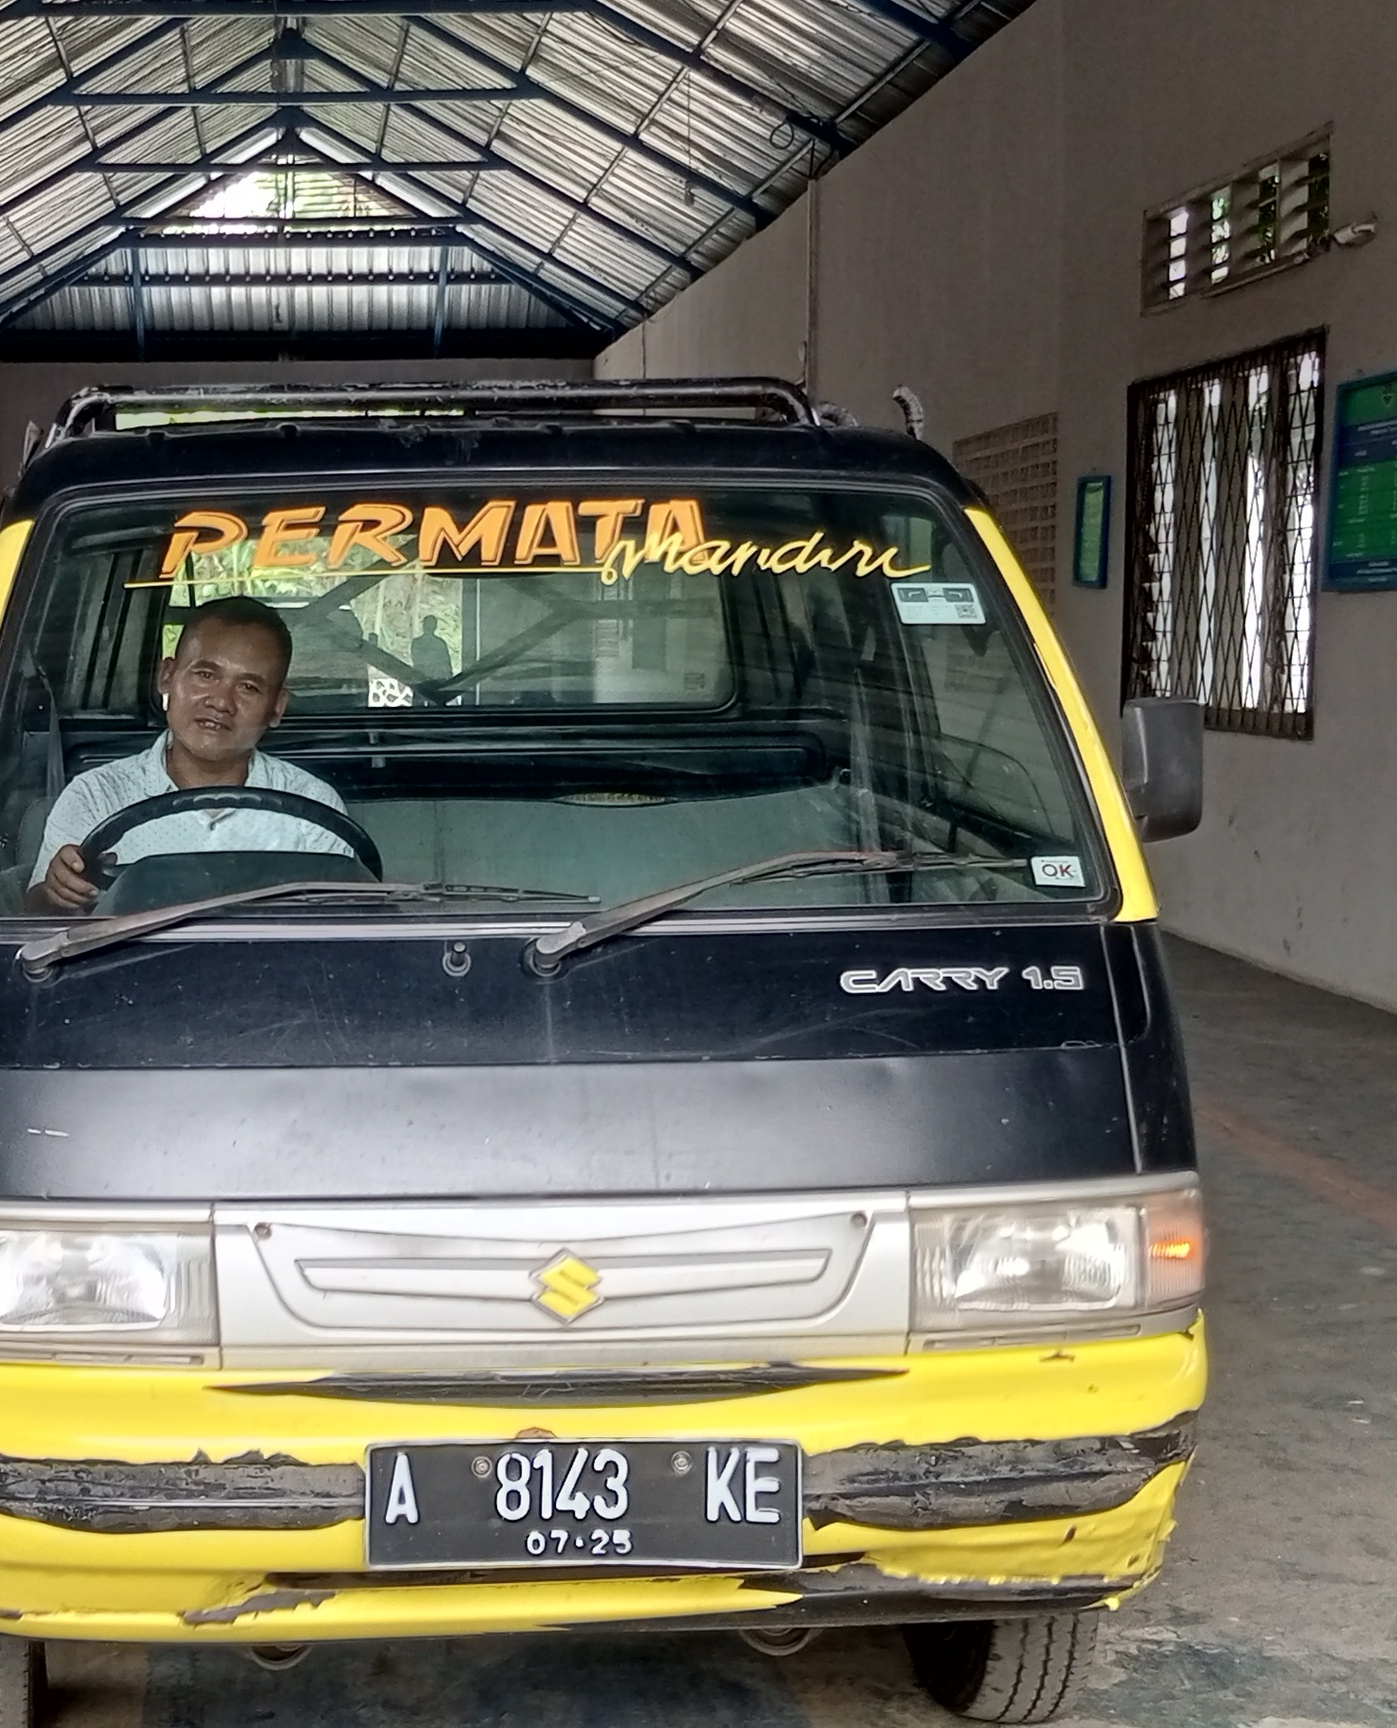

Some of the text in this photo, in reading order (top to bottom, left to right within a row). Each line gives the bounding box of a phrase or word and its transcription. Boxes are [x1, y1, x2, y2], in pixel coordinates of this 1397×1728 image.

[160, 499, 708, 579] PERMATA
[1041, 863, 1075, 878] OK
[839, 965, 1085, 994] CARRY 1.5
[383, 1446, 781, 1525] A 8143 KE
